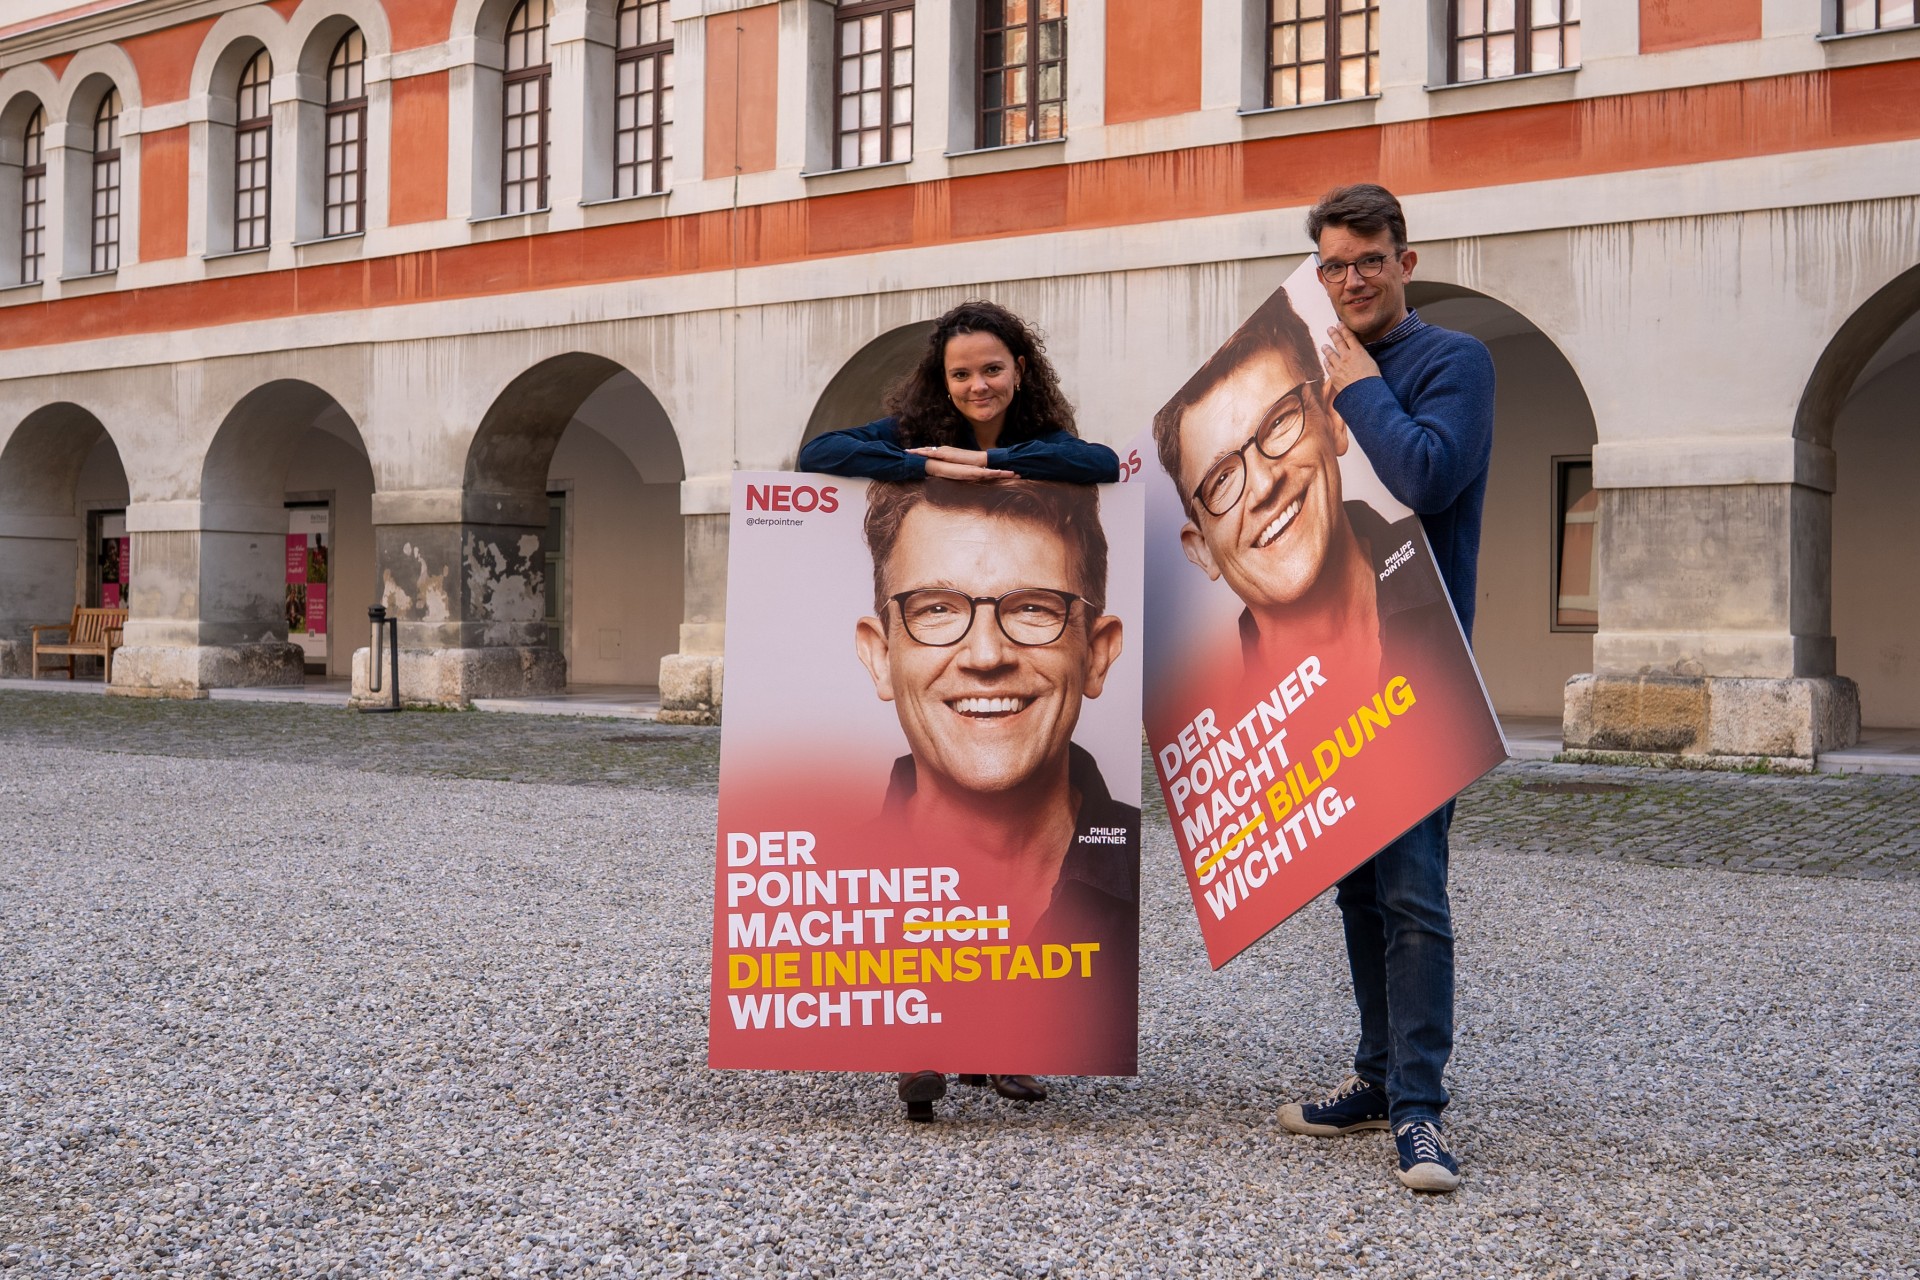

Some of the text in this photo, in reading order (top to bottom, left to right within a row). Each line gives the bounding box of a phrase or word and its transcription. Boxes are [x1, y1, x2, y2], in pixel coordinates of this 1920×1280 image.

[746, 484, 839, 513] NEOS
[746, 517, 804, 527] @derpointner
[1379, 547, 1416, 582] POINTNER
[1384, 540, 1412, 567] PHILIPP
[1158, 707, 1221, 781] DER
[1170, 655, 1328, 817] POINTNER
[1180, 727, 1289, 851] MACHT
[1194, 675, 1417, 886] SICH BILDUNG
[727, 831, 816, 867] DER
[1078, 835, 1127, 845] POINTNER
[1090, 827, 1127, 836] PHILIPP
[1204, 786, 1356, 921] WICHTIG.
[727, 866, 960, 908] POINTNER
[727, 905, 1010, 948] MACHT SICH
[728, 942, 1100, 989] DIE INNENSTADT
[727, 988, 942, 1030] WICHTIG.
